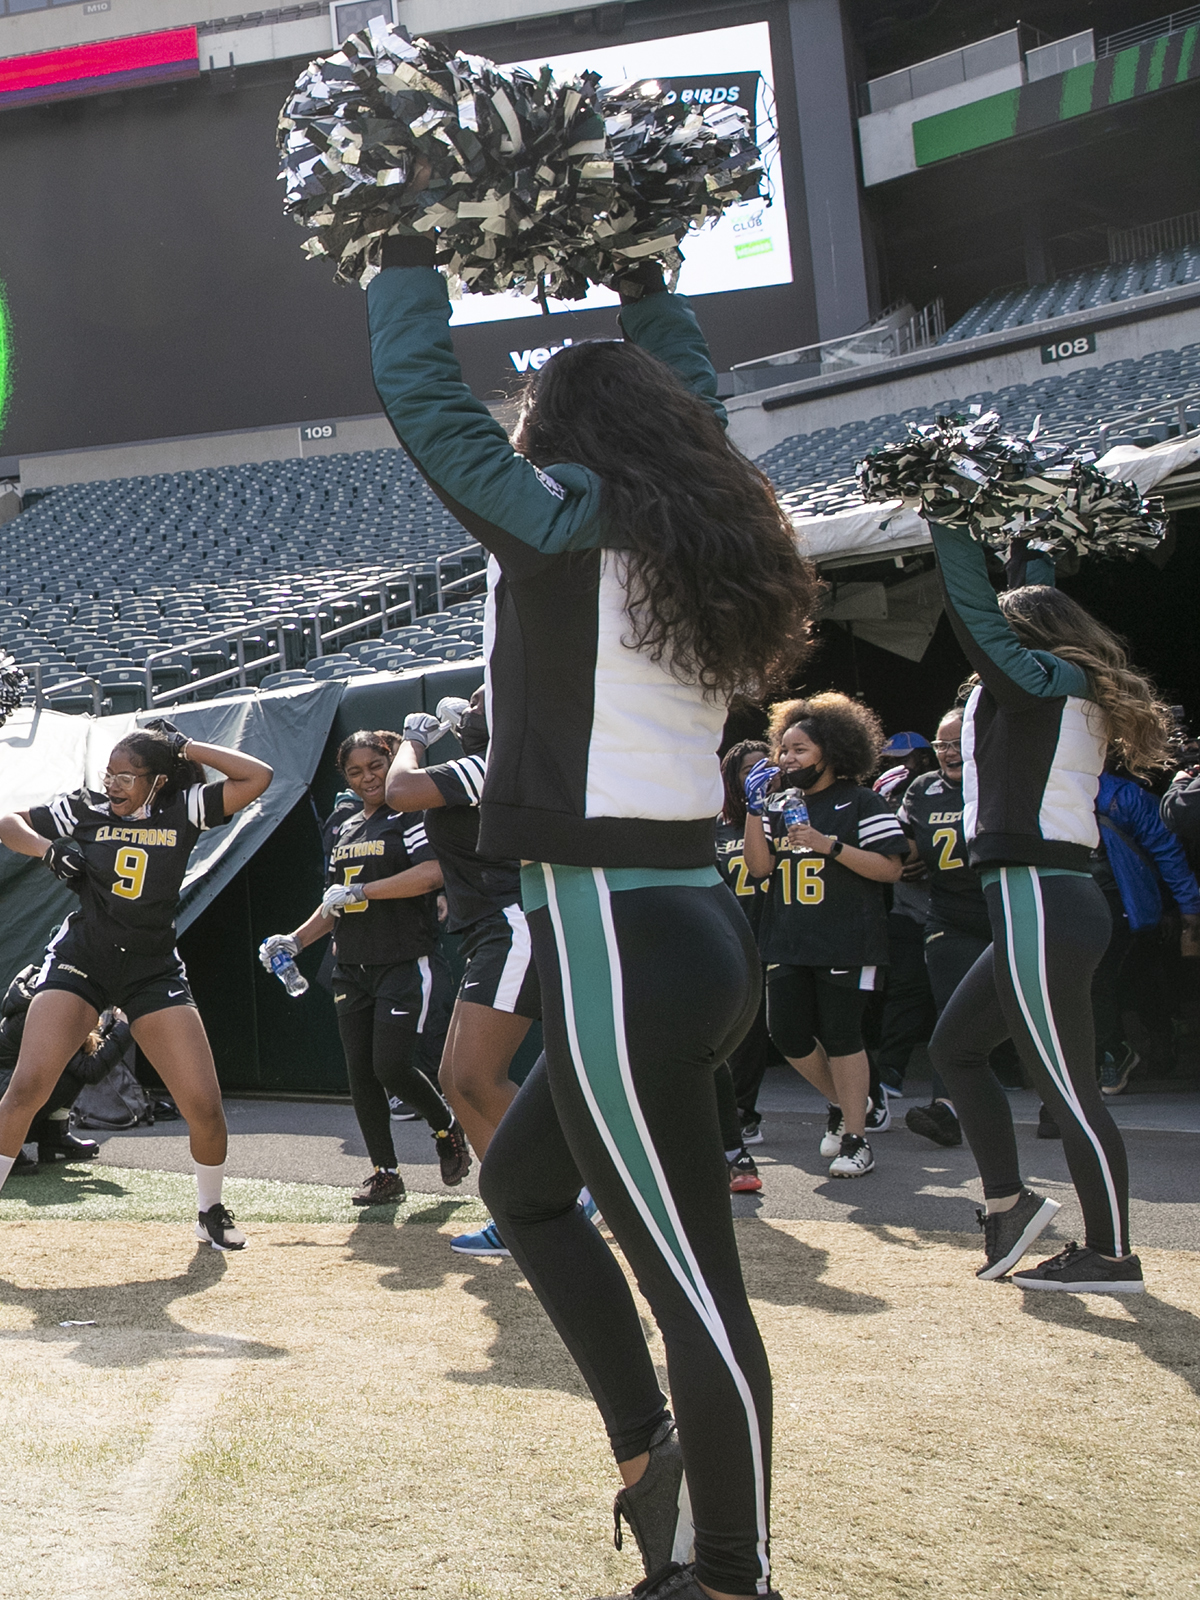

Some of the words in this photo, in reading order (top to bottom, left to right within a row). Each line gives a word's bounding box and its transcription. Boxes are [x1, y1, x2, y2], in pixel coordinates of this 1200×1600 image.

[87, 3, 108, 13] M10
[681, 86, 740, 104] BIRDS
[732, 218, 763, 232] CLUB
[1047, 337, 1090, 360] 108
[304, 425, 333, 439] 109
[95, 825, 178, 847] ELECTRONS
[333, 840, 386, 862] LECTRONS
[111, 845, 149, 901] 9
[777, 858, 825, 905] 16
